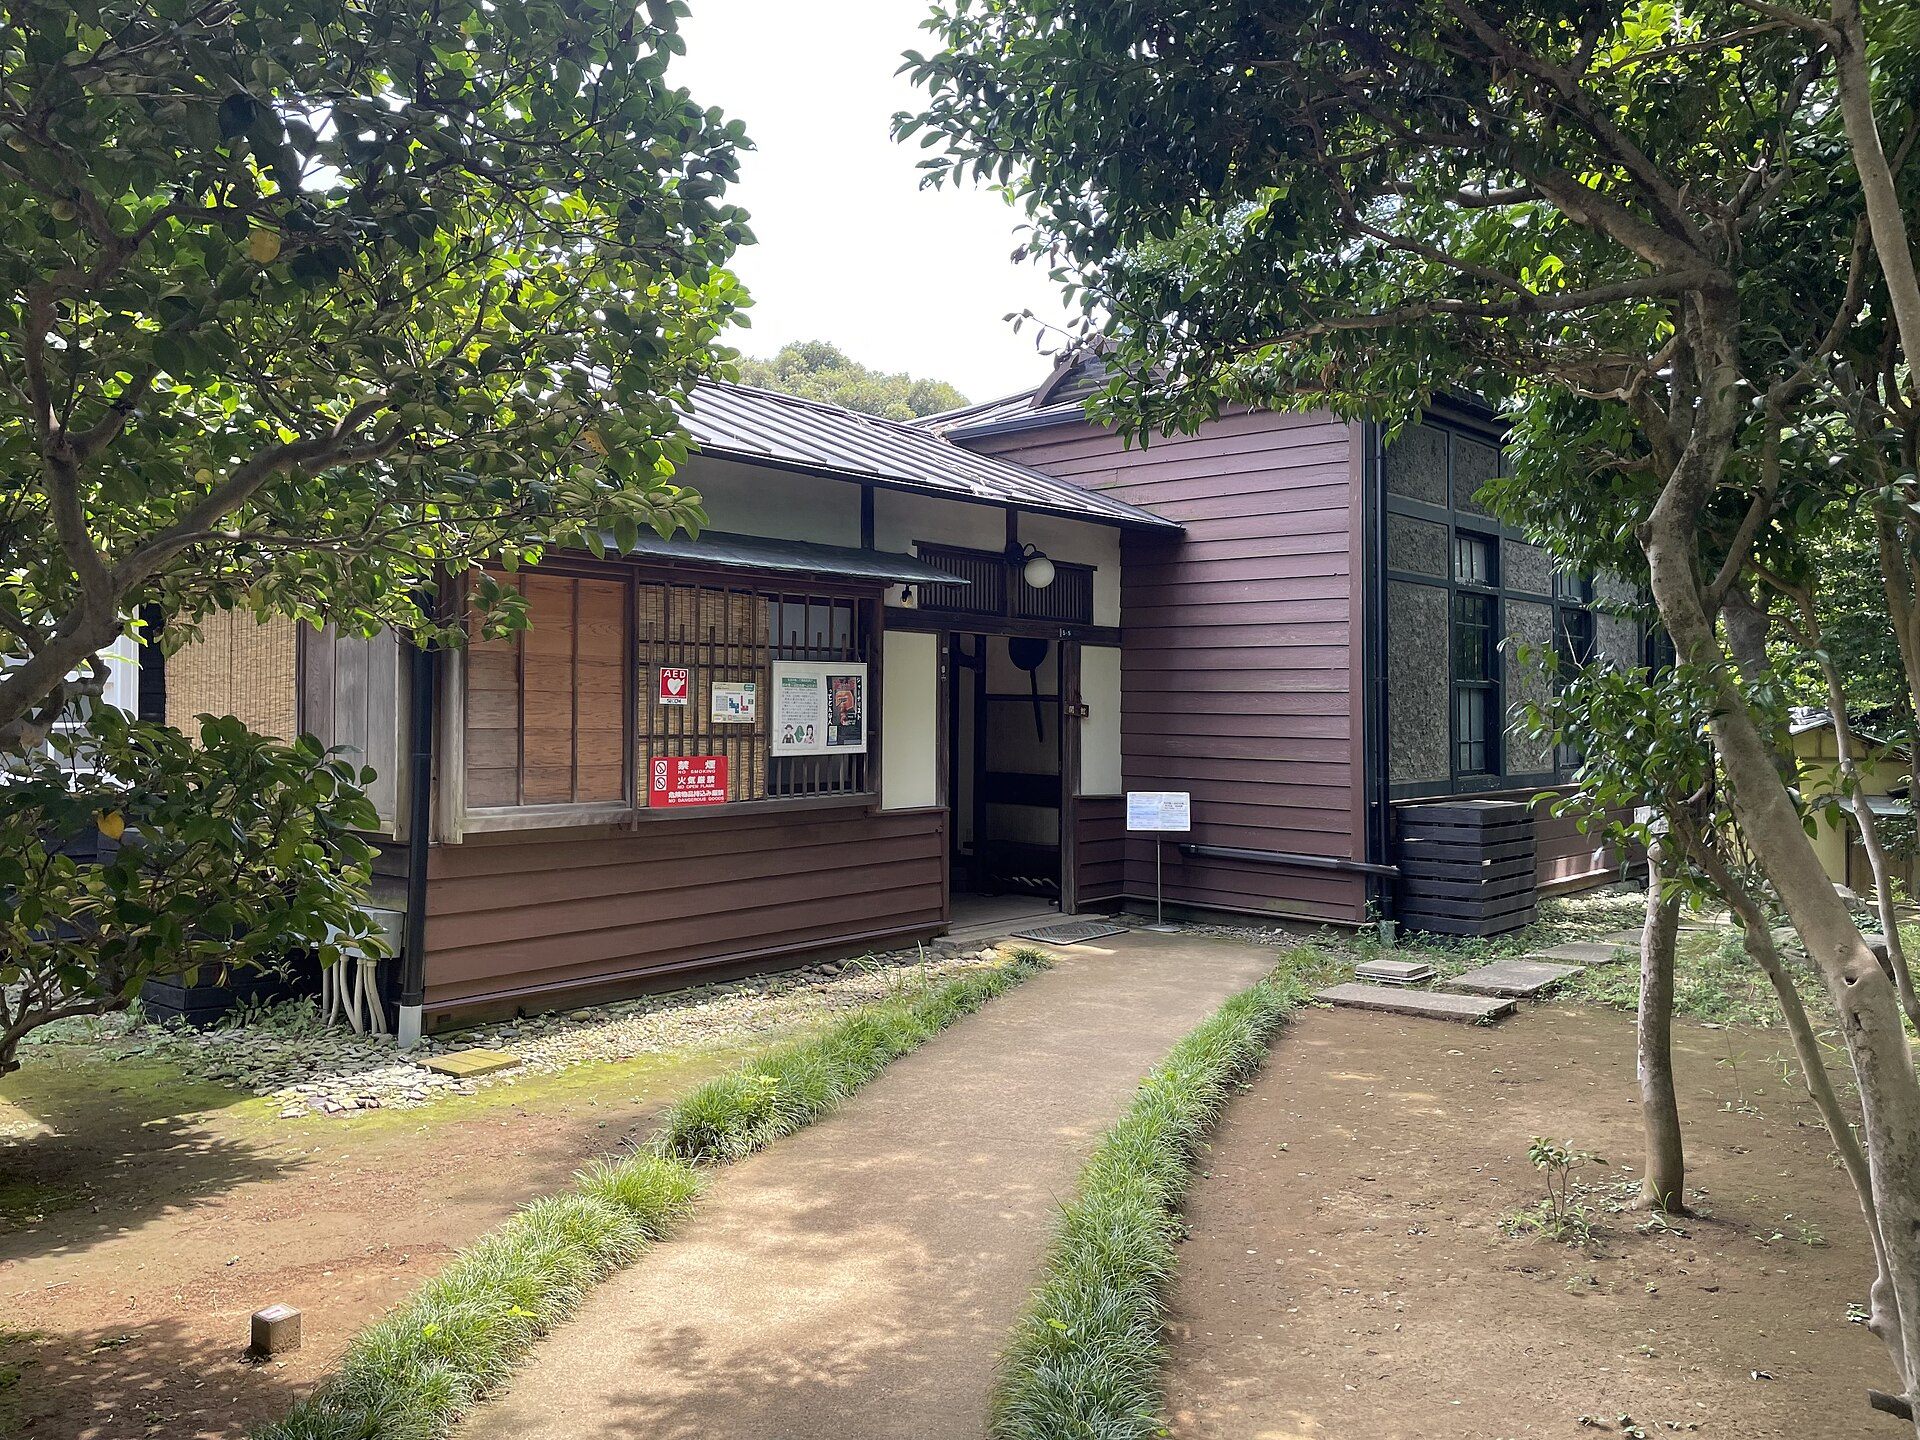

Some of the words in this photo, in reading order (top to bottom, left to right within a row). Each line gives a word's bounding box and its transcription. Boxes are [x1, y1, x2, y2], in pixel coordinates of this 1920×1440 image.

[663, 670, 686, 678] AED
[677, 776, 715, 785] 火気厳禁
